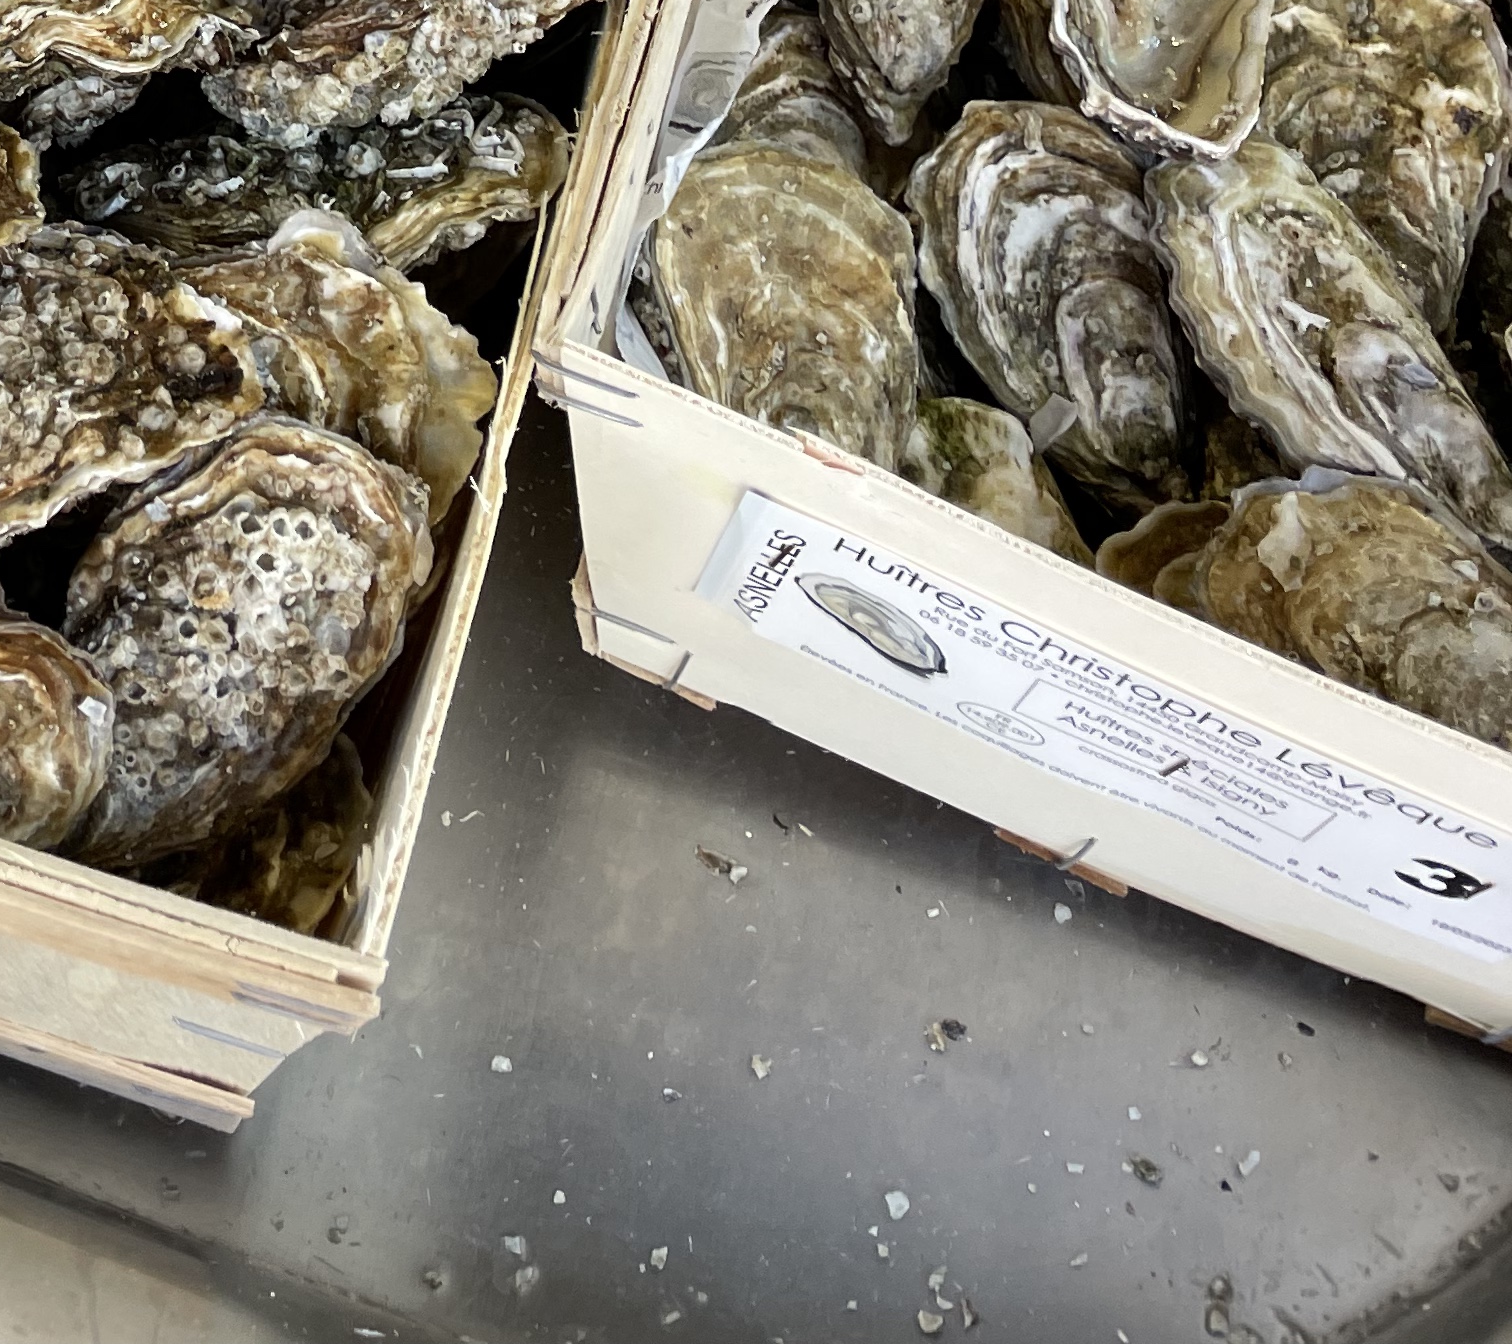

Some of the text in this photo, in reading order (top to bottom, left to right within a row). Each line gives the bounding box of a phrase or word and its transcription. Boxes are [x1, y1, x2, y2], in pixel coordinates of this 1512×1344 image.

[833, 537, 1499, 849] Huîtres Christophe Lévêque
[1064, 700, 1154, 745] Huîtres
[1056, 715, 1165, 763] Asnelles
[1200, 775, 1277, 815] Isigny
